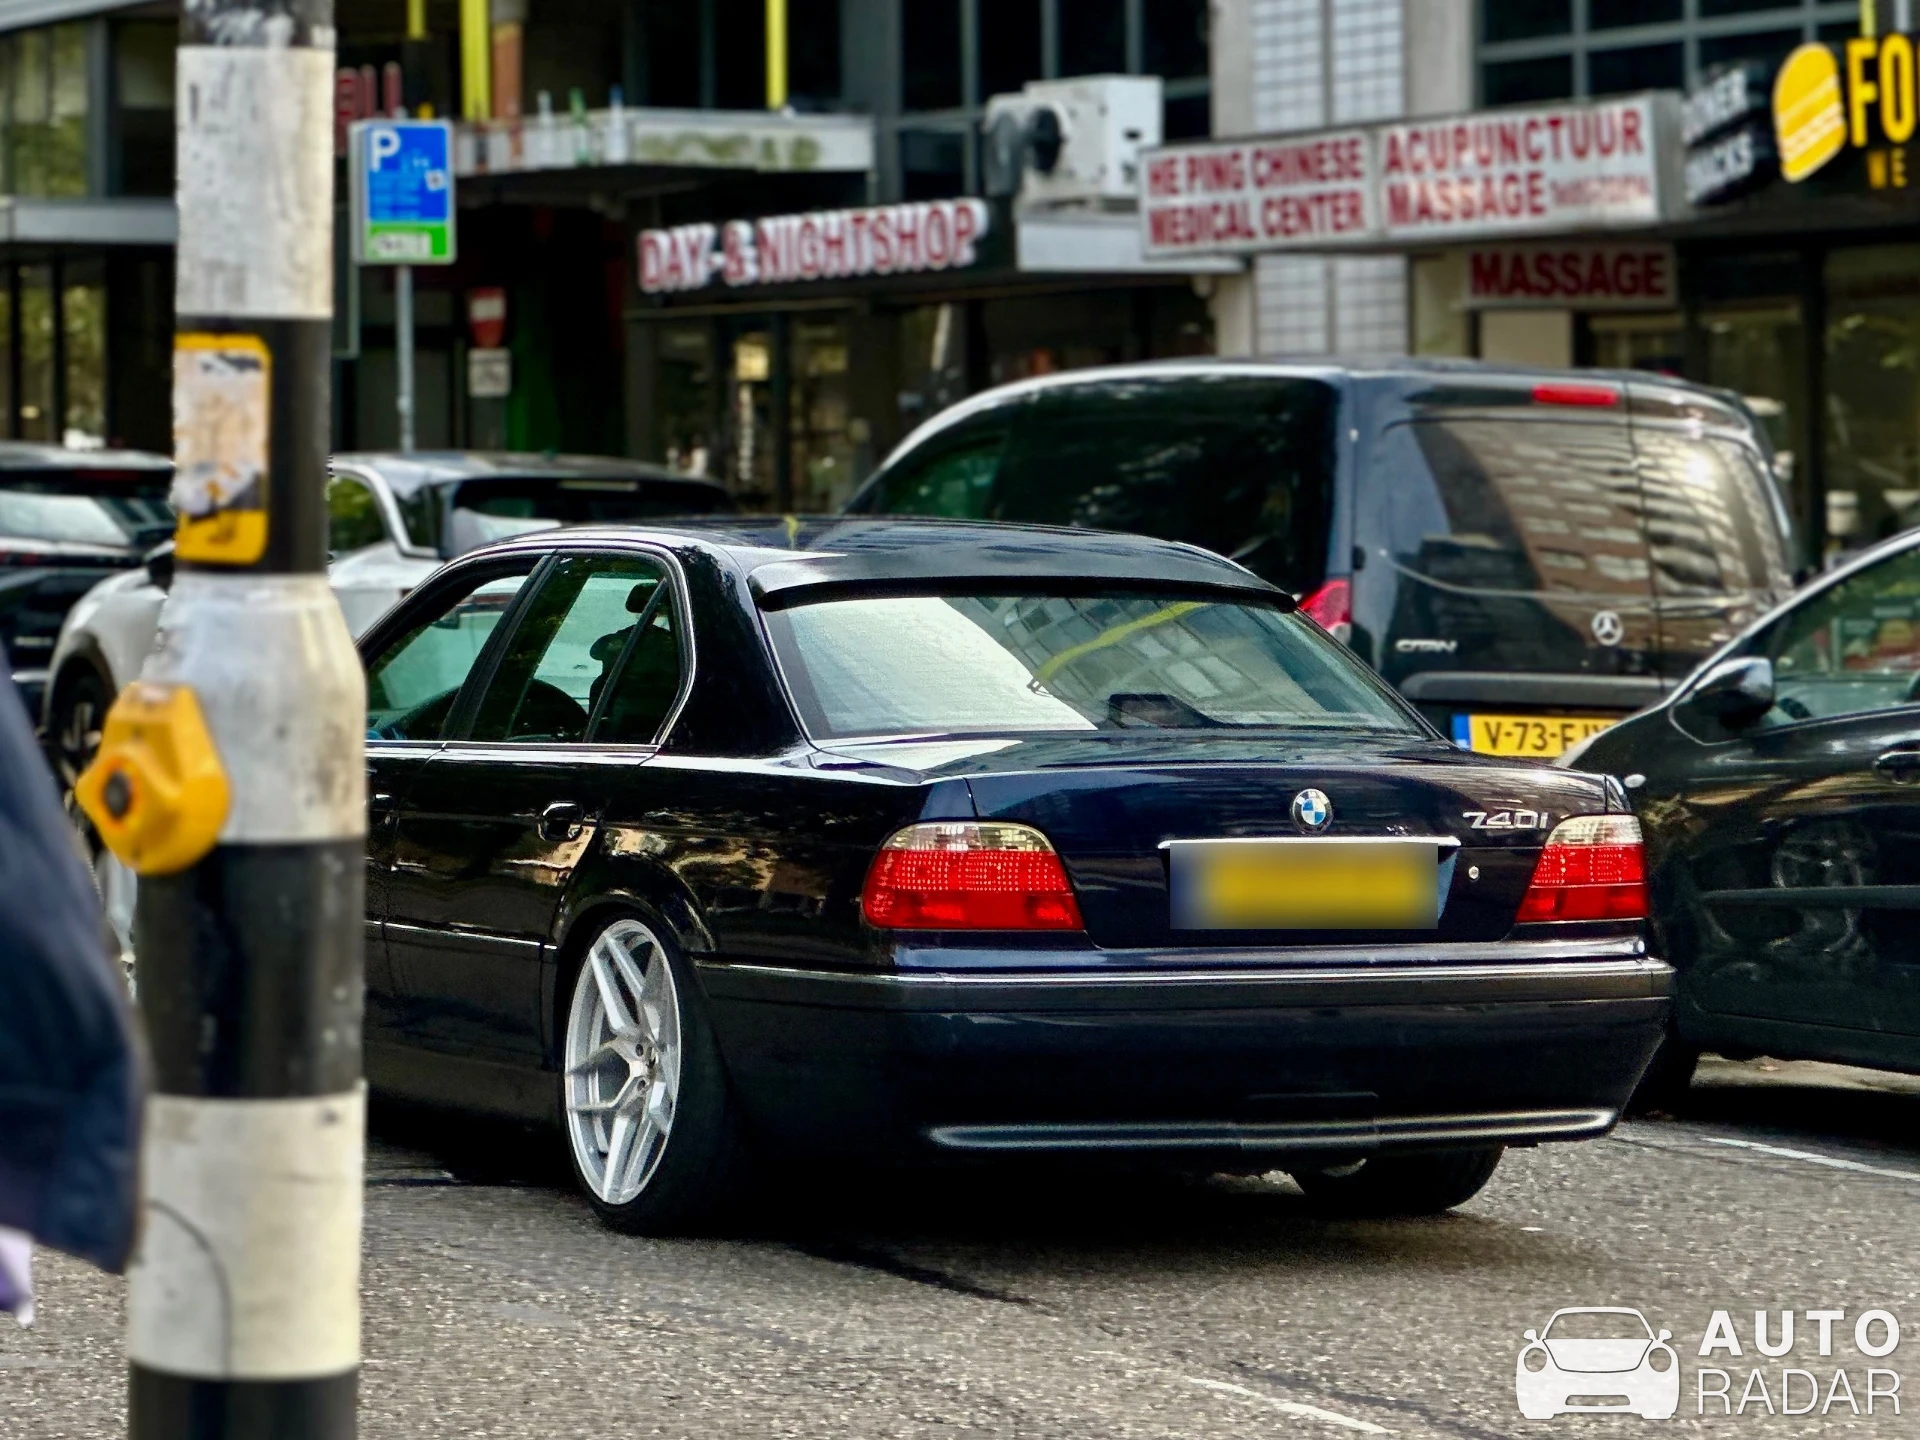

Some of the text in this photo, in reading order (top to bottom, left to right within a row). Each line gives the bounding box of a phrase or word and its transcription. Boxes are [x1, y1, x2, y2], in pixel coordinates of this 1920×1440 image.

[1847, 32, 1920, 147] FO
[370, 128, 401, 173] P
[1185, 149, 1246, 193] PING
[1252, 137, 1364, 190] CHINESE
[1384, 107, 1644, 176] ACUPUNCTUUR
[1148, 190, 1365, 248] MEDICAL CENTER
[1386, 169, 1547, 227] MASSAGE
[1469, 252, 1668, 297] MASSAGE
[1484, 721, 1611, 752] V-73-F
